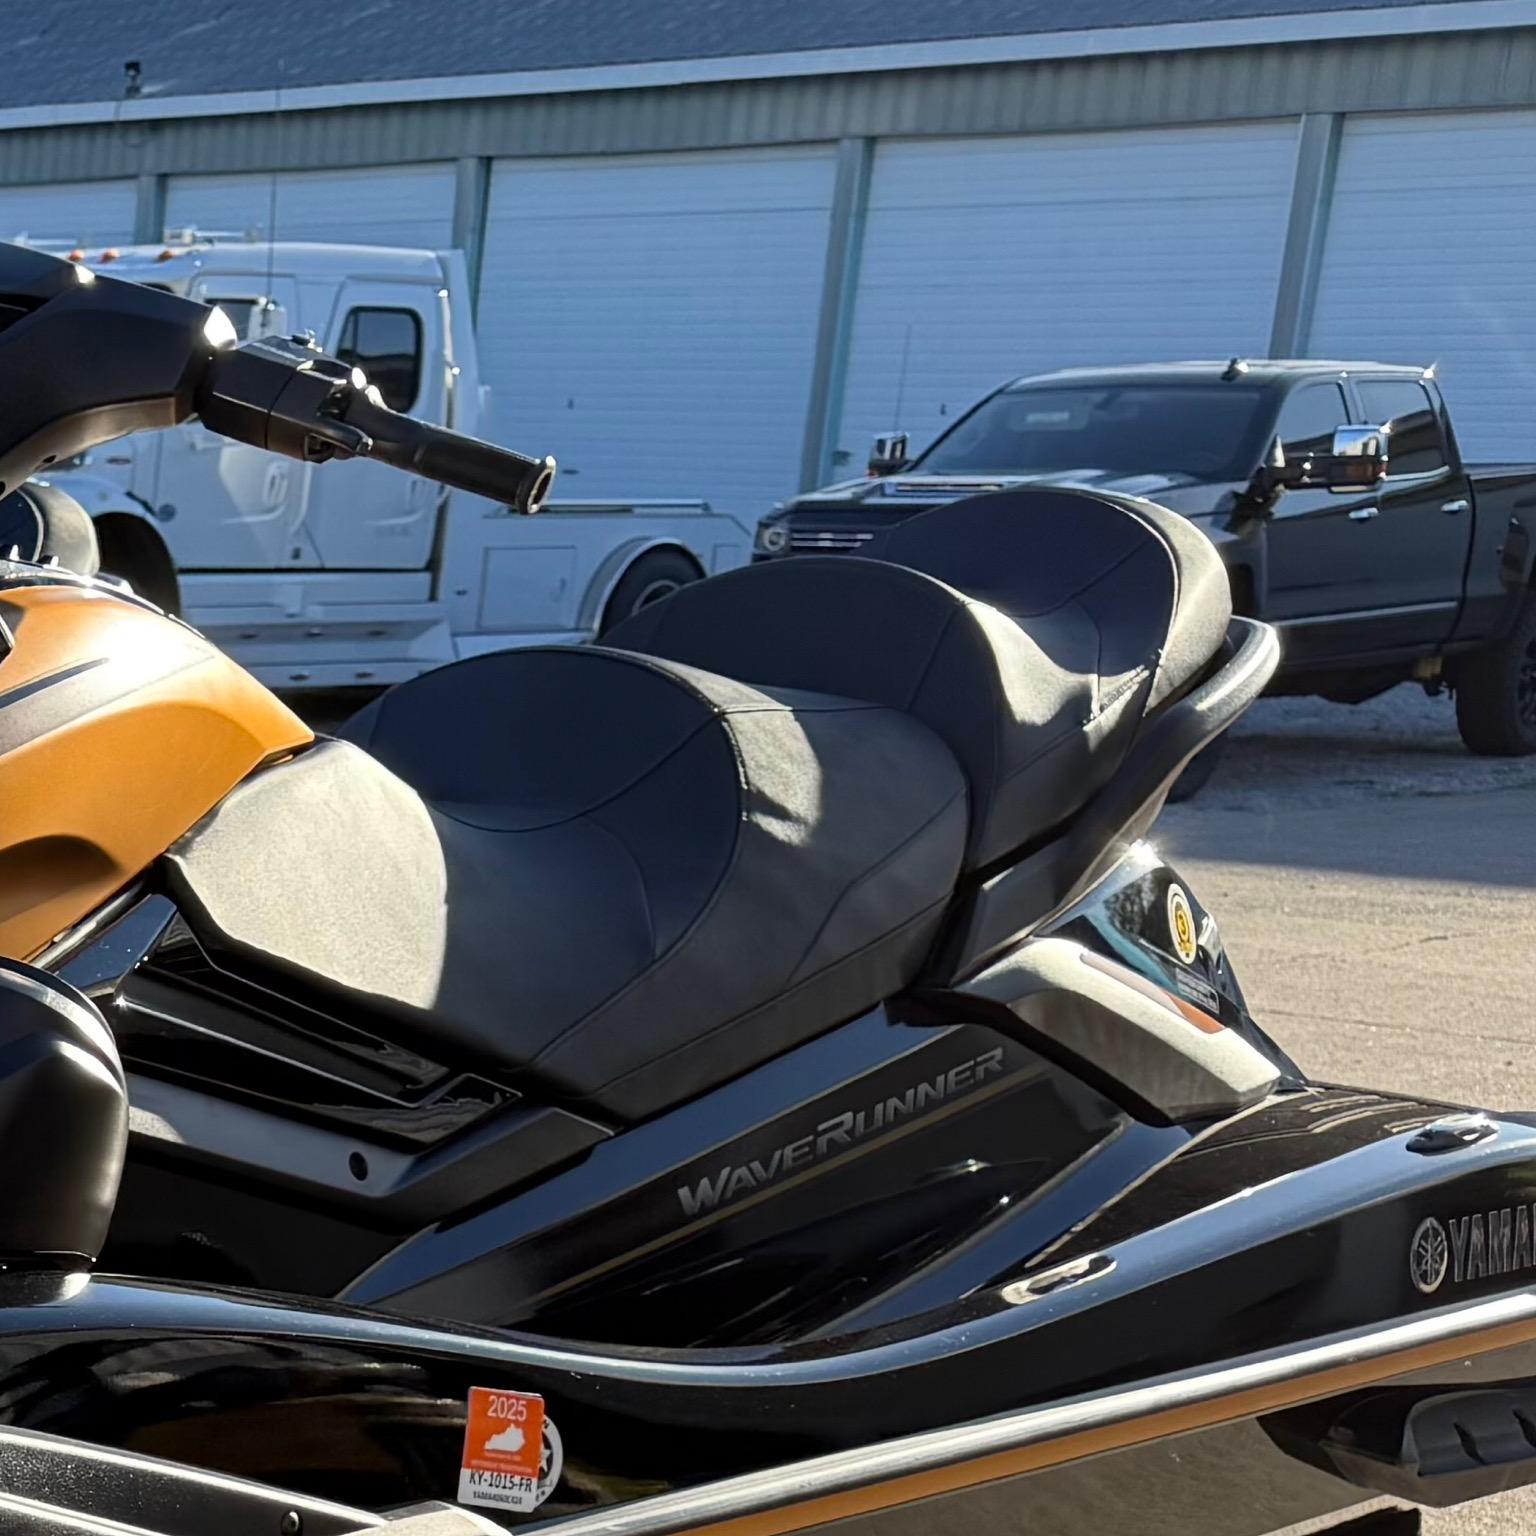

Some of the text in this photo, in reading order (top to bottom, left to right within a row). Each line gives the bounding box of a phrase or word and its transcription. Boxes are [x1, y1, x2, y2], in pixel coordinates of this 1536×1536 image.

[1448, 1202, 1536, 1283] YAMA
[488, 1395, 528, 1422] 2025
[469, 1470, 532, 1493] KY-1015-FR
